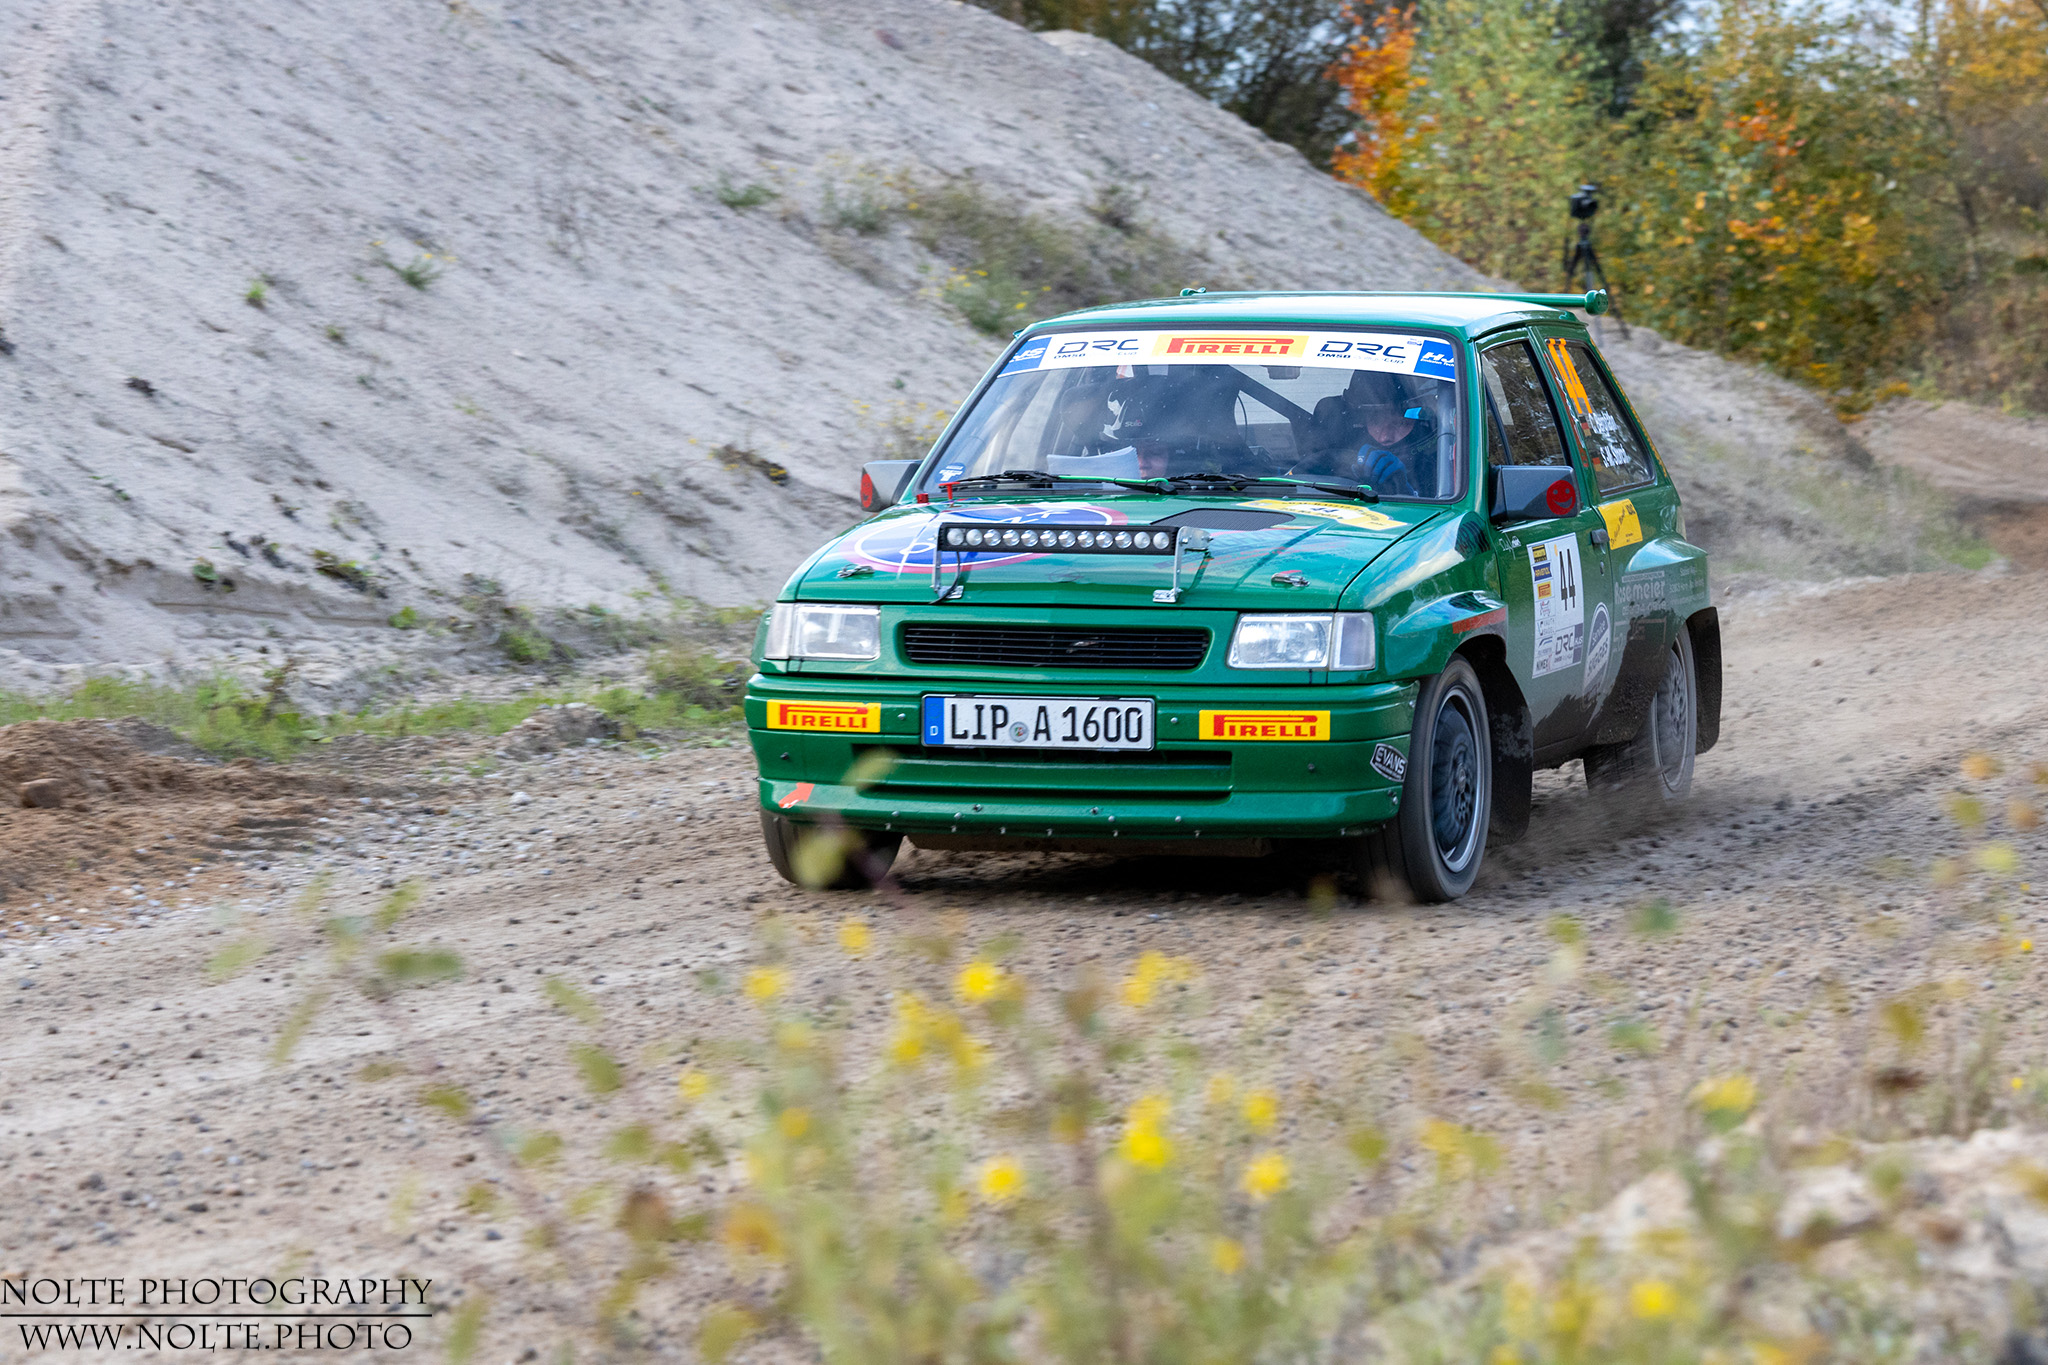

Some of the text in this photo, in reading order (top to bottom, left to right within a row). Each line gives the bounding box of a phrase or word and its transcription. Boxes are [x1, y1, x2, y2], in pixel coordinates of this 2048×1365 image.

[1057, 339, 1139, 354] DRC
[1166, 337, 1295, 355] PIRELLI
[1320, 341, 1406, 359] DRC
[1547, 338, 1593, 414] 44
[1559, 548, 1576, 611] 44
[1555, 632, 1574, 655] DRC
[779, 703, 868, 729] PIRELLI
[951, 704, 1143, 743] LIP A 1600
[1213, 714, 1317, 737] PIRELLI
[929, 725, 938, 736] D
[1375, 747, 1406, 775] EVANS
